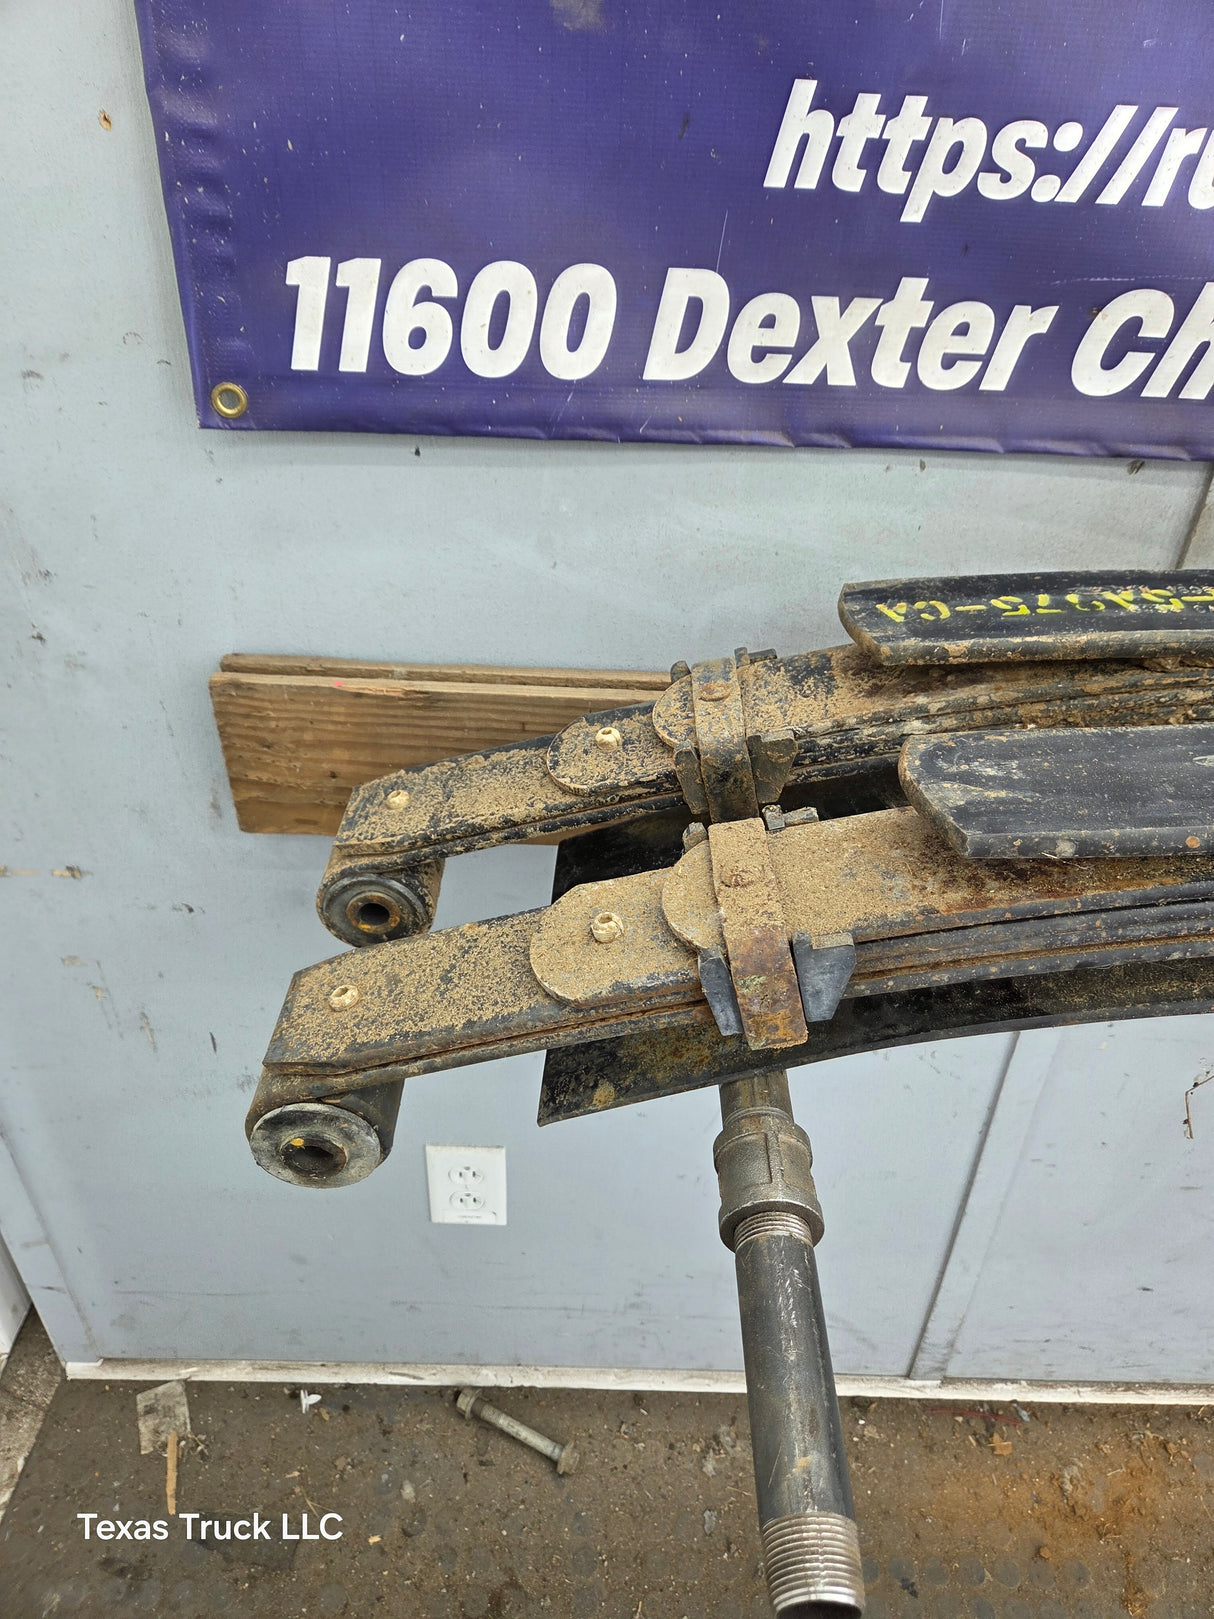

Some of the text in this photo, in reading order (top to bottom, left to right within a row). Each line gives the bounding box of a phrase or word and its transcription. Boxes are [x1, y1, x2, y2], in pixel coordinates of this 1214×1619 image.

[286, 256, 1214, 400] 11600 Dexter Ch
